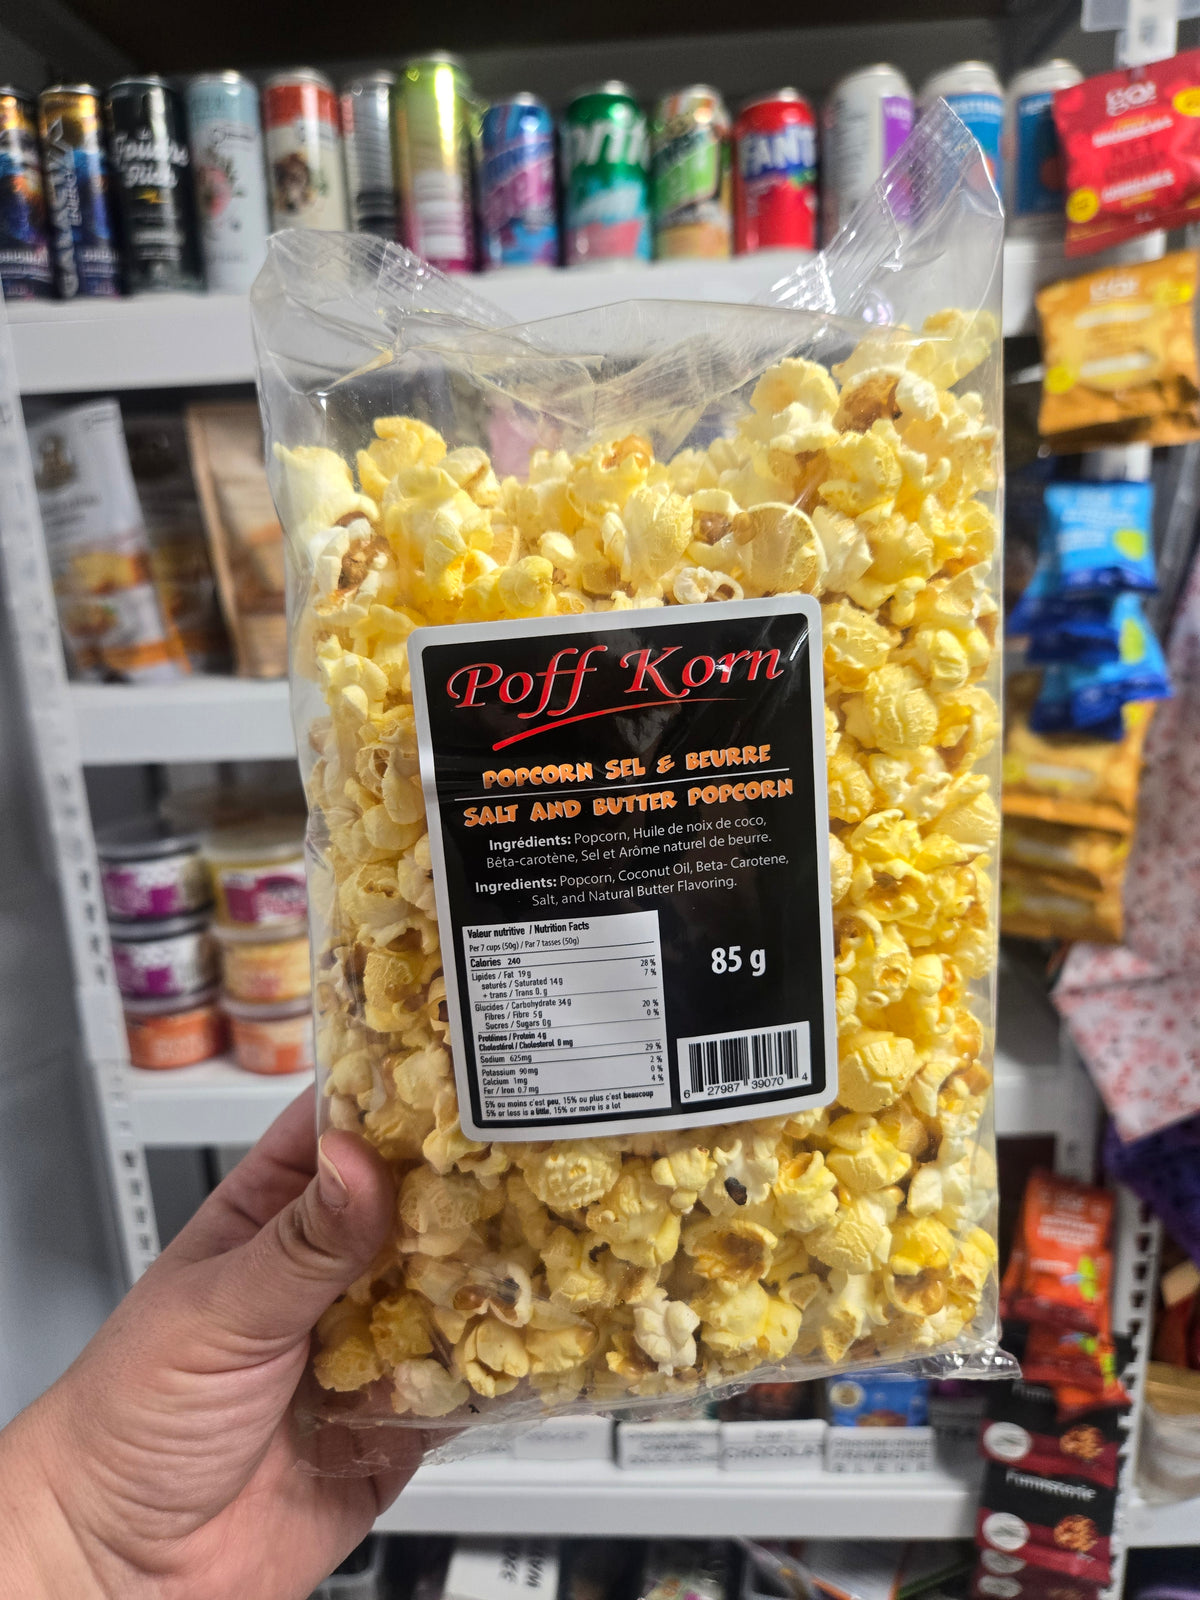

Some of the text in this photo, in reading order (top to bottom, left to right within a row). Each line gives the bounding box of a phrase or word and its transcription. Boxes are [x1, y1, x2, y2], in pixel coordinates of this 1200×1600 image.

[739, 125, 816, 178] FANT
[446, 645, 785, 720] Poff Korn
[482, 744, 771, 789] POPCORN SEL & BEURRE
[463, 778, 793, 827] SALT AND BUTTER POPCORN
[489, 816, 767, 852] Ingrédients: Popcorn, Huile de noix de coco,
[581, 849, 600, 862] Sel
[603, 849, 615, 860] et
[619, 844, 660, 858] Arôme
[663, 837, 706, 853] naturel
[709, 835, 725, 847] de
[728, 833, 772, 846] beurre.
[475, 854, 789, 895] Ingredients: Popcorn, Coconut Oil, Beta- Carotene,
[532, 877, 737, 907] Salt, and Natural Butter Flavoring.
[467, 928, 491, 939] Valeur
[493, 926, 525, 937] nutritive
[534, 923, 567, 934] Nutrition
[568, 921, 590, 931] Facts
[469, 944, 479, 952] Per
[486, 943, 501, 952] cups
[502, 941, 519, 951] (50g)
[525, 940, 535, 948] Par
[562, 936, 580, 946] (50g)
[470, 957, 521, 968] Calories 240
[471, 972, 496, 981] Lipides
[504, 971, 514, 979] Fat
[640, 959, 649, 967] 28
[711, 945, 766, 977] 85 g
[514, 977, 547, 987] Saturated
[644, 968, 648, 976] 7
[489, 990, 507, 999] trans
[515, 988, 533, 996] Trans
[474, 1003, 504, 1012] Glucides
[511, 999, 556, 1010] Carbohydrate
[484, 1012, 505, 1021] Fibres
[513, 1010, 530, 1019] Fibre
[485, 1021, 509, 1030] Sucres
[516, 1020, 540, 1030] Sugars
[646, 1008, 651, 1016] 0
[513, 1032, 536, 1041] Protein
[519, 1039, 555, 1049] Cholesterol
[480, 1055, 505, 1064] Sodium
[482, 1067, 516, 1076] Potassium
[650, 1055, 654, 1063] 2
[482, 1077, 509, 1086] Calcium
[651, 1064, 655, 1072] 0
[683, 1072, 808, 1099] 6 27987 39070 4
[483, 1086, 494, 1094] Fer
[501, 1086, 515, 1094] Iron
[507, 1099, 527, 1107] moins
[563, 1096, 577, 1104] 15%
[589, 1094, 604, 1103] plus
[623, 1090, 654, 1099] beaucoup
[486, 1109, 497, 1117] 5%
[507, 1109, 521, 1117] less
[523, 1108, 529, 1116] is
[554, 1106, 568, 1114] 15%
[579, 1104, 596, 1112] more
[611, 1101, 621, 1109] lot
